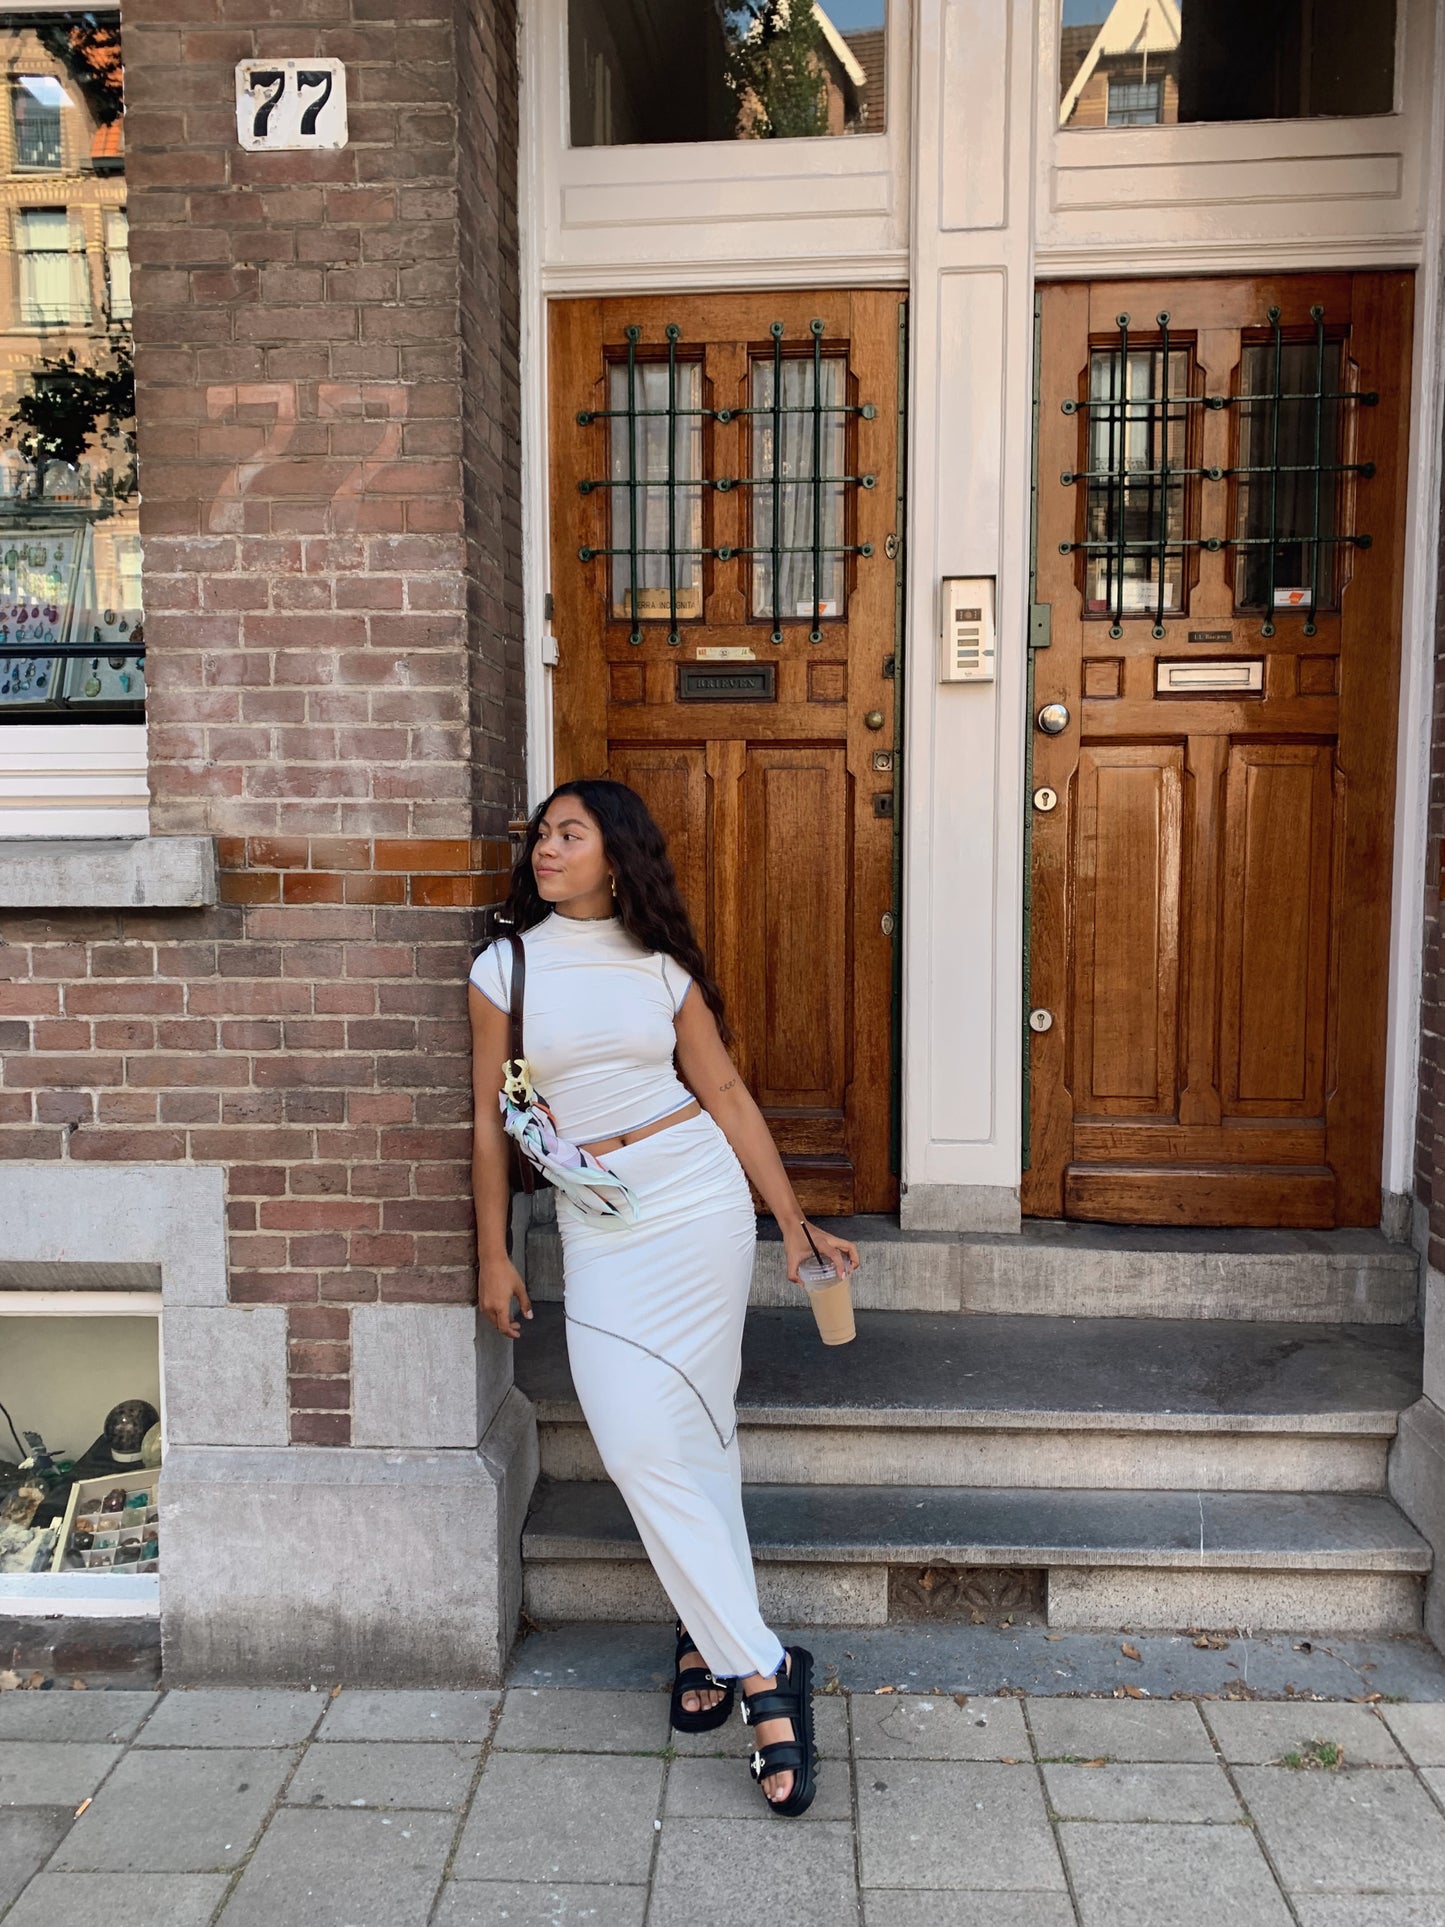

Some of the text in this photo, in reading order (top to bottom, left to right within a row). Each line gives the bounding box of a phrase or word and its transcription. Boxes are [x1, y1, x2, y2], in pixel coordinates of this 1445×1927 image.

[250, 71, 332, 136] 77
[206, 383, 408, 535] 77
[634, 600, 696, 610] ERRA INCGNITA
[696, 679, 757, 689] BRIEVEN
